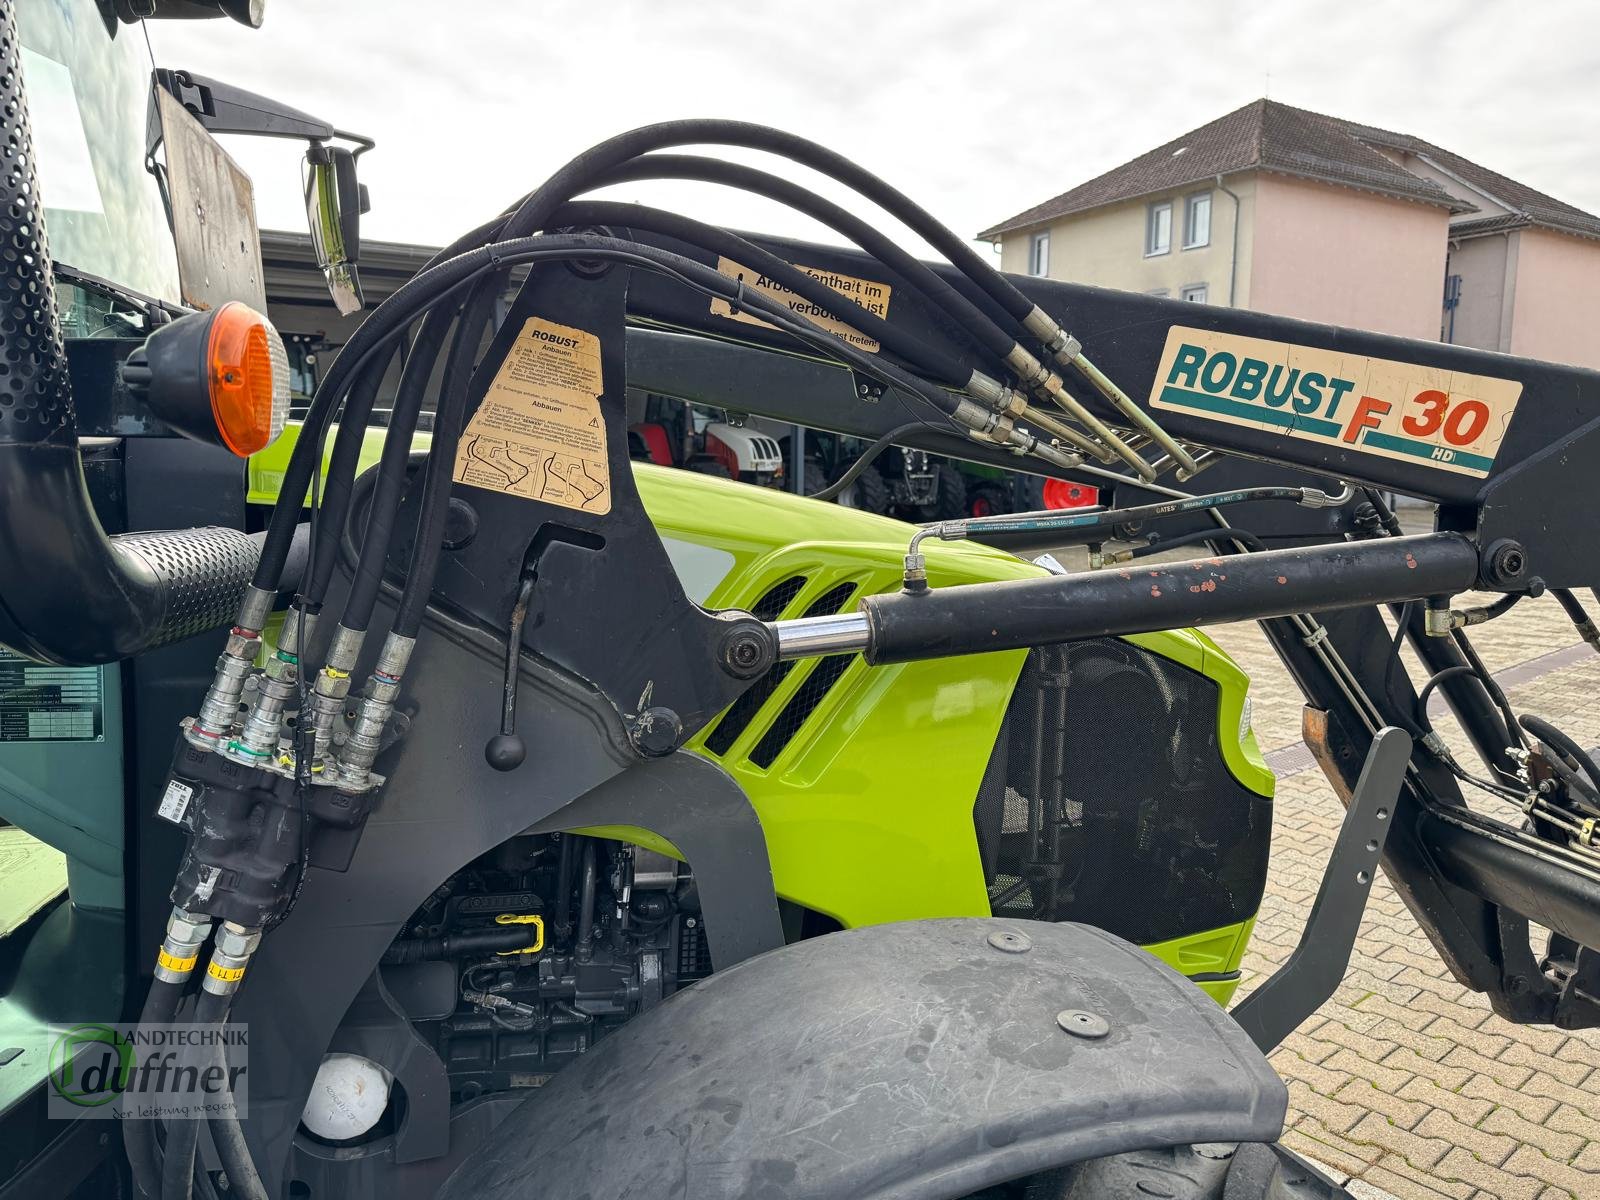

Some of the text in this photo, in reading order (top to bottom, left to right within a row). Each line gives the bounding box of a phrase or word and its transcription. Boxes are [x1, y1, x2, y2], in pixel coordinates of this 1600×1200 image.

[865, 283, 882, 298] im
[867, 300, 884, 315] ist
[532, 330, 579, 348] ROBUST
[850, 334, 877, 347] treten!
[542, 345, 572, 357] Anbauen
[1167, 344, 1355, 419] ROBUST
[532, 400, 562, 412] Abbauen
[1431, 447, 1454, 462] HD
